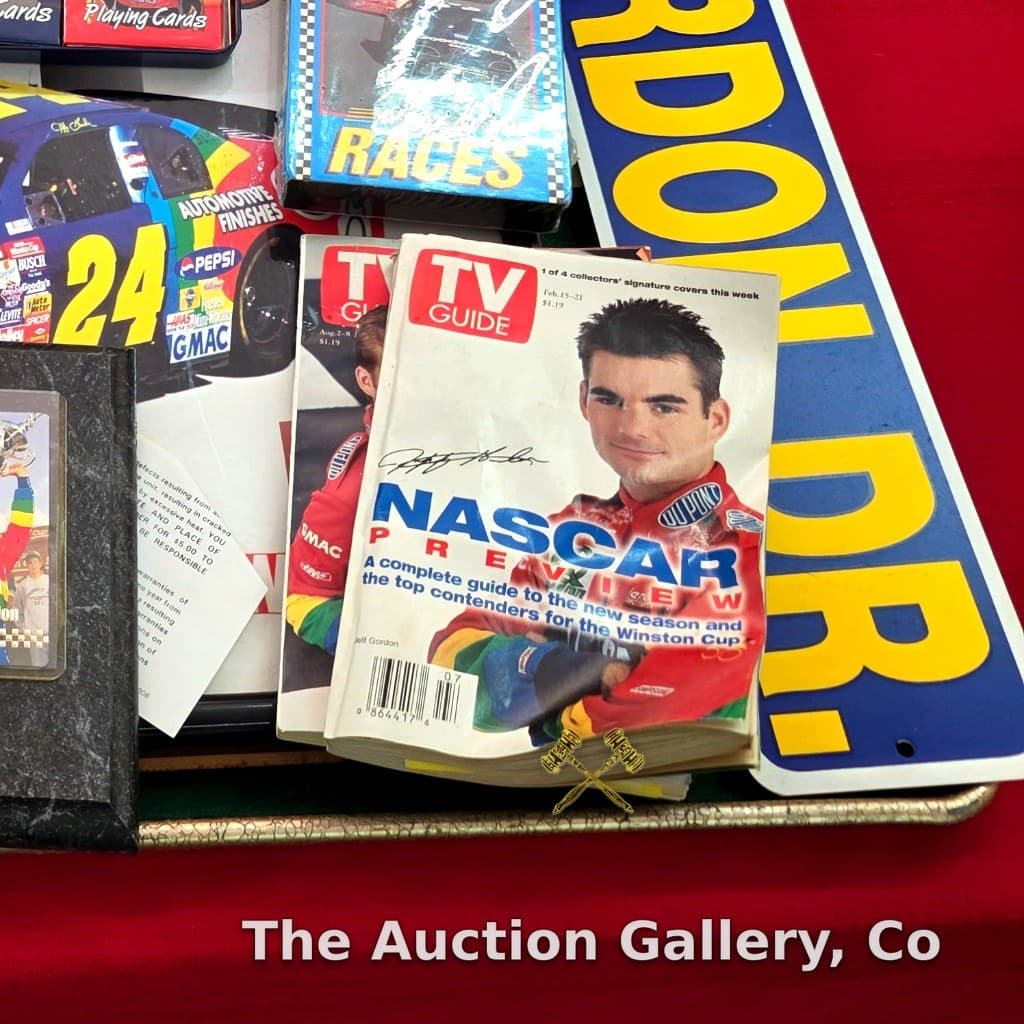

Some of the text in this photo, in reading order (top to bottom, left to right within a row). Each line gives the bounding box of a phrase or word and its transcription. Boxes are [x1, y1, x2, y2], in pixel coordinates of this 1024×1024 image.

[83, 2, 208, 30] Playing Cards
[328, 126, 529, 191] RACES
[177, 184, 274, 221] AUTOMOTIVE
[217, 202, 284, 234] FINISHES
[17, 254, 47, 272] BUSCH
[194, 249, 236, 274] PEPSI
[52, 222, 170, 347] 24
[430, 252, 527, 315] TV
[548, 268, 760, 301] of signature covers this week
[428, 303, 512, 337] GUIDE
[172, 325, 230, 361] GMAC
[160, 477, 212, 512] resulting from
[160, 490, 233, 538] resulting cracked
[151, 509, 222, 556] AND PLACE OF
[152, 523, 215, 566] FOR TO
[208, 531, 227, 547] YOU
[371, 481, 739, 591] NASCAR
[138, 527, 209, 577] BE RESPONSIBLE
[163, 600, 182, 616] from
[178, 597, 189, 607] of
[361, 571, 742, 647] the top contenders for the Winston Cup
[363, 555, 743, 632] A complete guide to the new season and
[143, 600, 177, 627] resulting
[368, 636, 400, 648] Gordon
